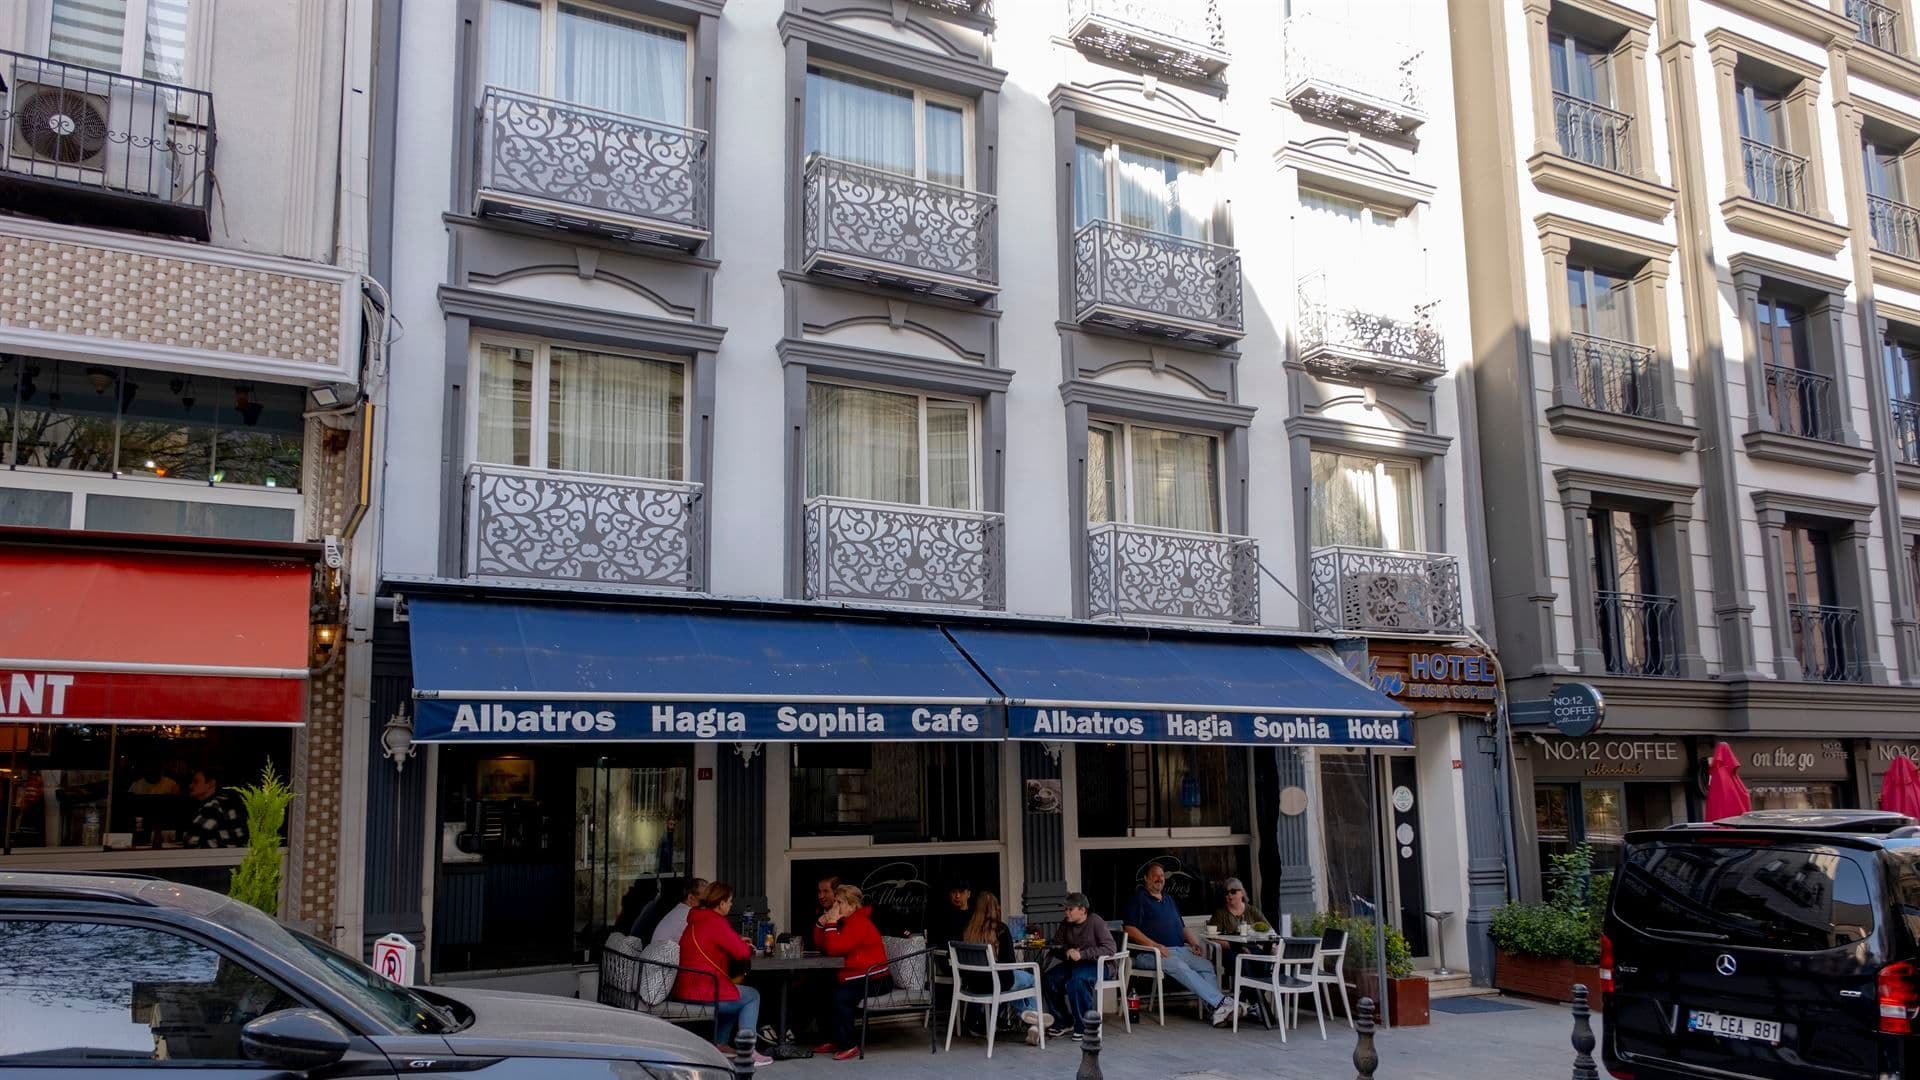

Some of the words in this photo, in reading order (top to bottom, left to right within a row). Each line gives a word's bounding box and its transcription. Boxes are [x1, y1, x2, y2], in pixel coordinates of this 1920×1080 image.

[1411, 653, 1496, 682] HOTEL
[0, 673, 74, 715] NT
[1409, 684, 1450, 698] HAGIA
[1553, 696, 1583, 706] NO:12
[451, 703, 616, 732] Albatros
[776, 706, 885, 738] Sophia
[911, 707, 979, 732] Cafe
[1554, 705, 1596, 717] COFFEE
[1033, 709, 1144, 735] Albatros
[1166, 713, 1233, 741] Hagia
[1253, 715, 1330, 743] Sophia
[1347, 718, 1399, 739] Hotel
[1544, 741, 1600, 760] NO:12
[1605, 741, 1678, 760] COFFEE
[1752, 753, 1770, 767] on
[1775, 747, 1795, 767] the
[1799, 752, 1815, 771] go
[1698, 1013, 1712, 1029] 34
[1720, 1016, 1744, 1034] CEA
[1753, 1022, 1778, 1040] 881
[409, 1060, 436, 1068] GT
